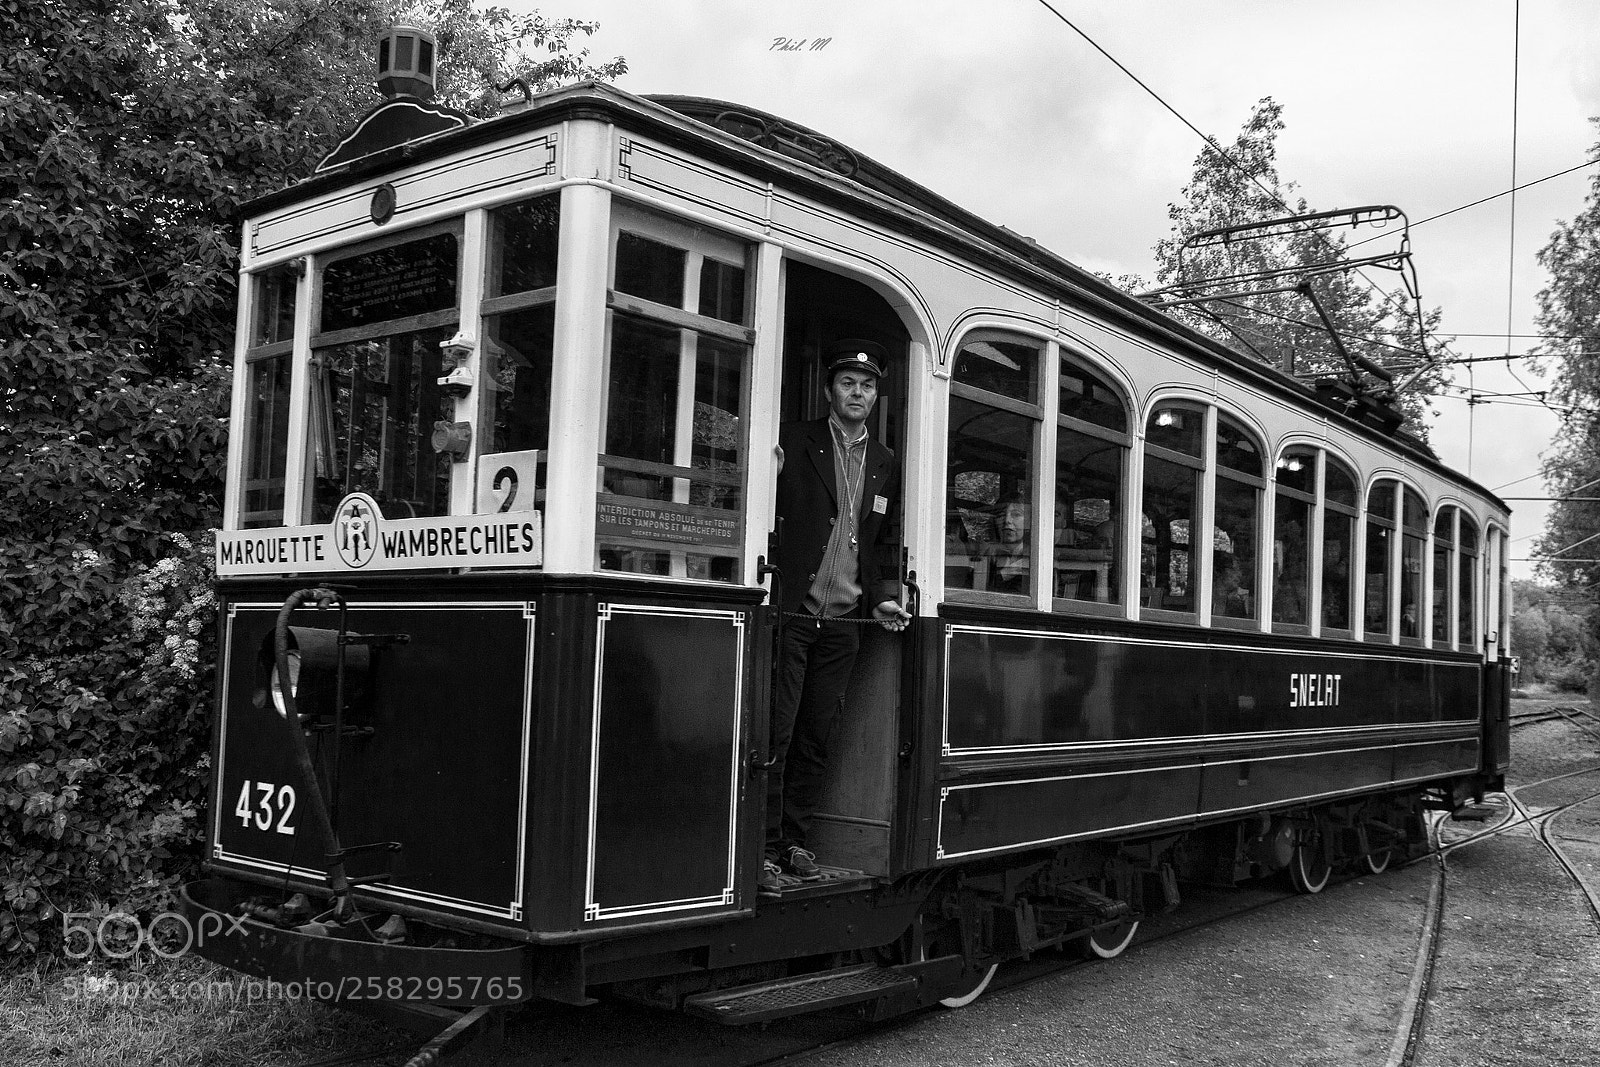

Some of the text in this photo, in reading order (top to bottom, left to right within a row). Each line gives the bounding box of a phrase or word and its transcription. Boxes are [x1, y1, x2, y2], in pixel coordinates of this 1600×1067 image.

[493, 465, 519, 513] 2
[597, 504, 656, 519] INTERDICTION
[658, 512, 696, 524] ABSOLUE
[714, 519, 736, 529] TENIR
[600, 514, 732, 538] SUR LES TAMPONS ET MARCHEPIEDS
[220, 522, 534, 566] MARQUETTE WAMBRECHIES
[235, 780, 296, 835] 432
